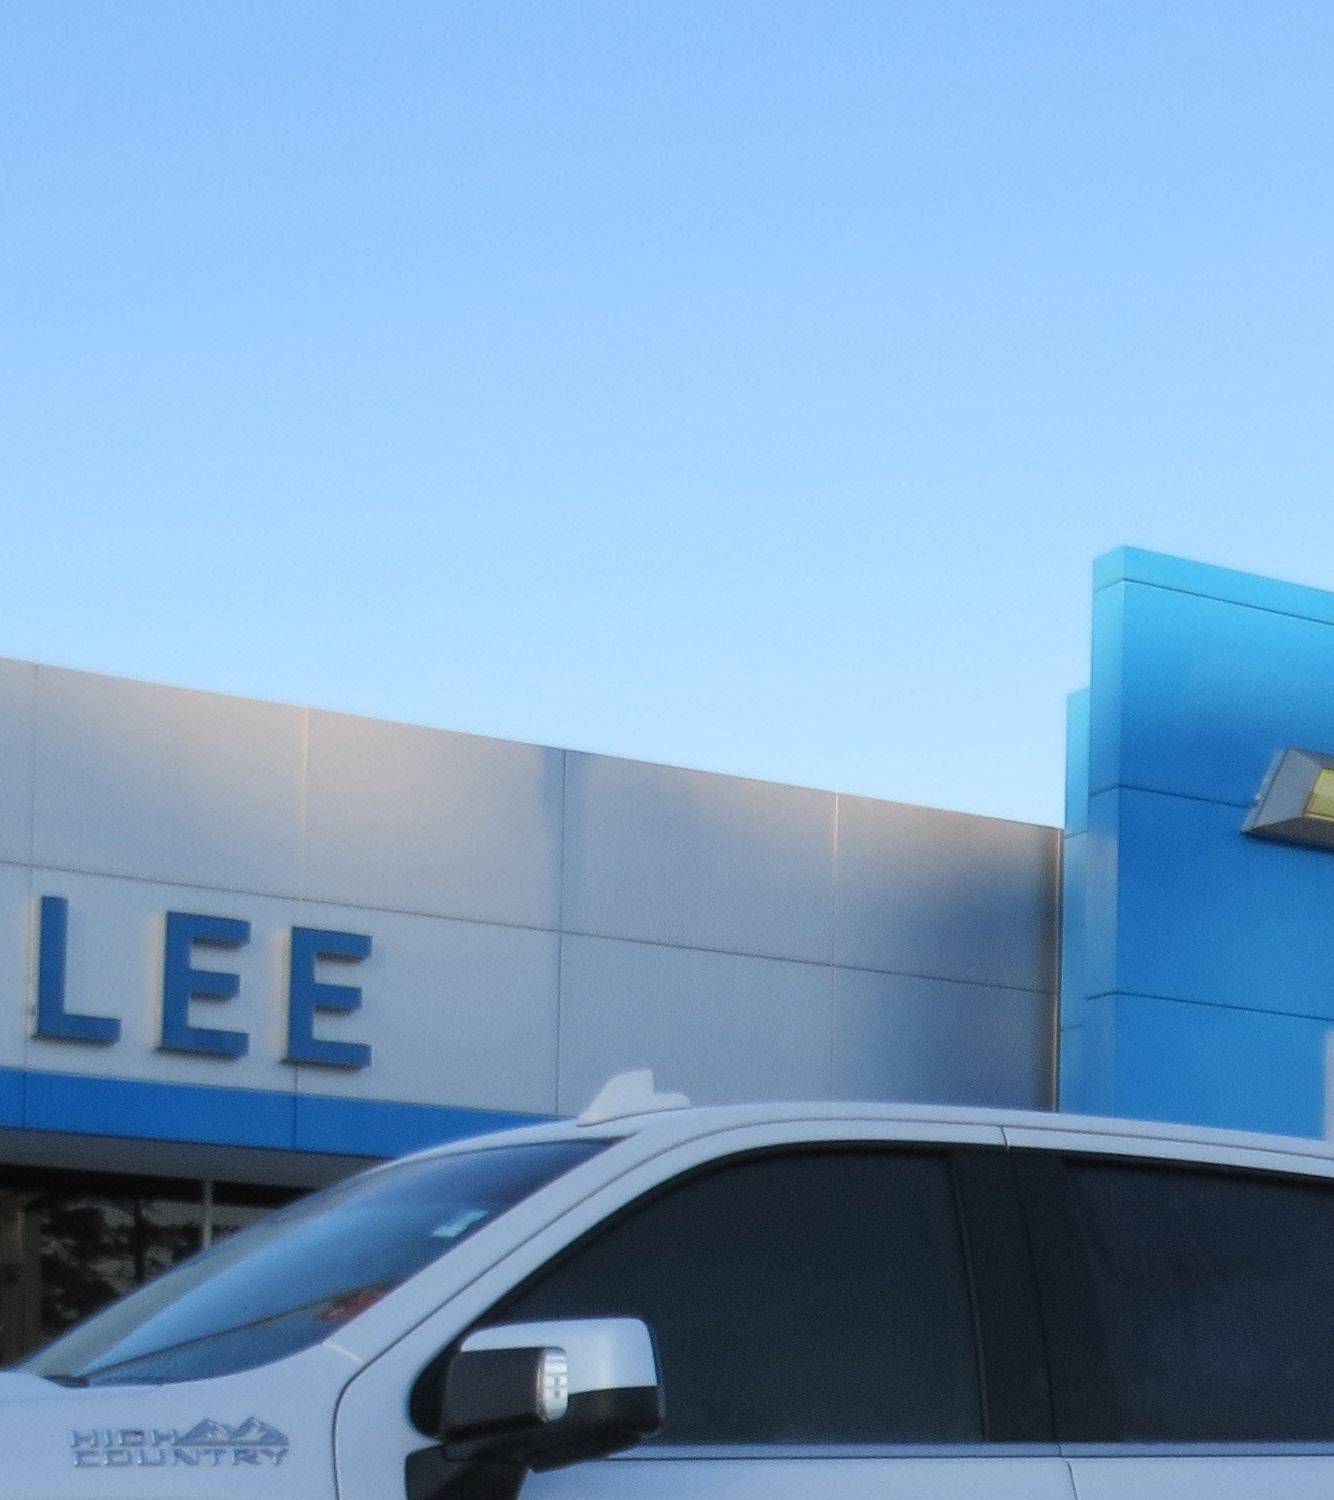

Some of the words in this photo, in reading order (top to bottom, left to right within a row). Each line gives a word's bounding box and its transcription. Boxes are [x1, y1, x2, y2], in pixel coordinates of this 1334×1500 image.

[27, 896, 371, 1069] LEE
[70, 1428, 180, 1448] HIGH
[72, 1448, 290, 1467] COUNTRY
